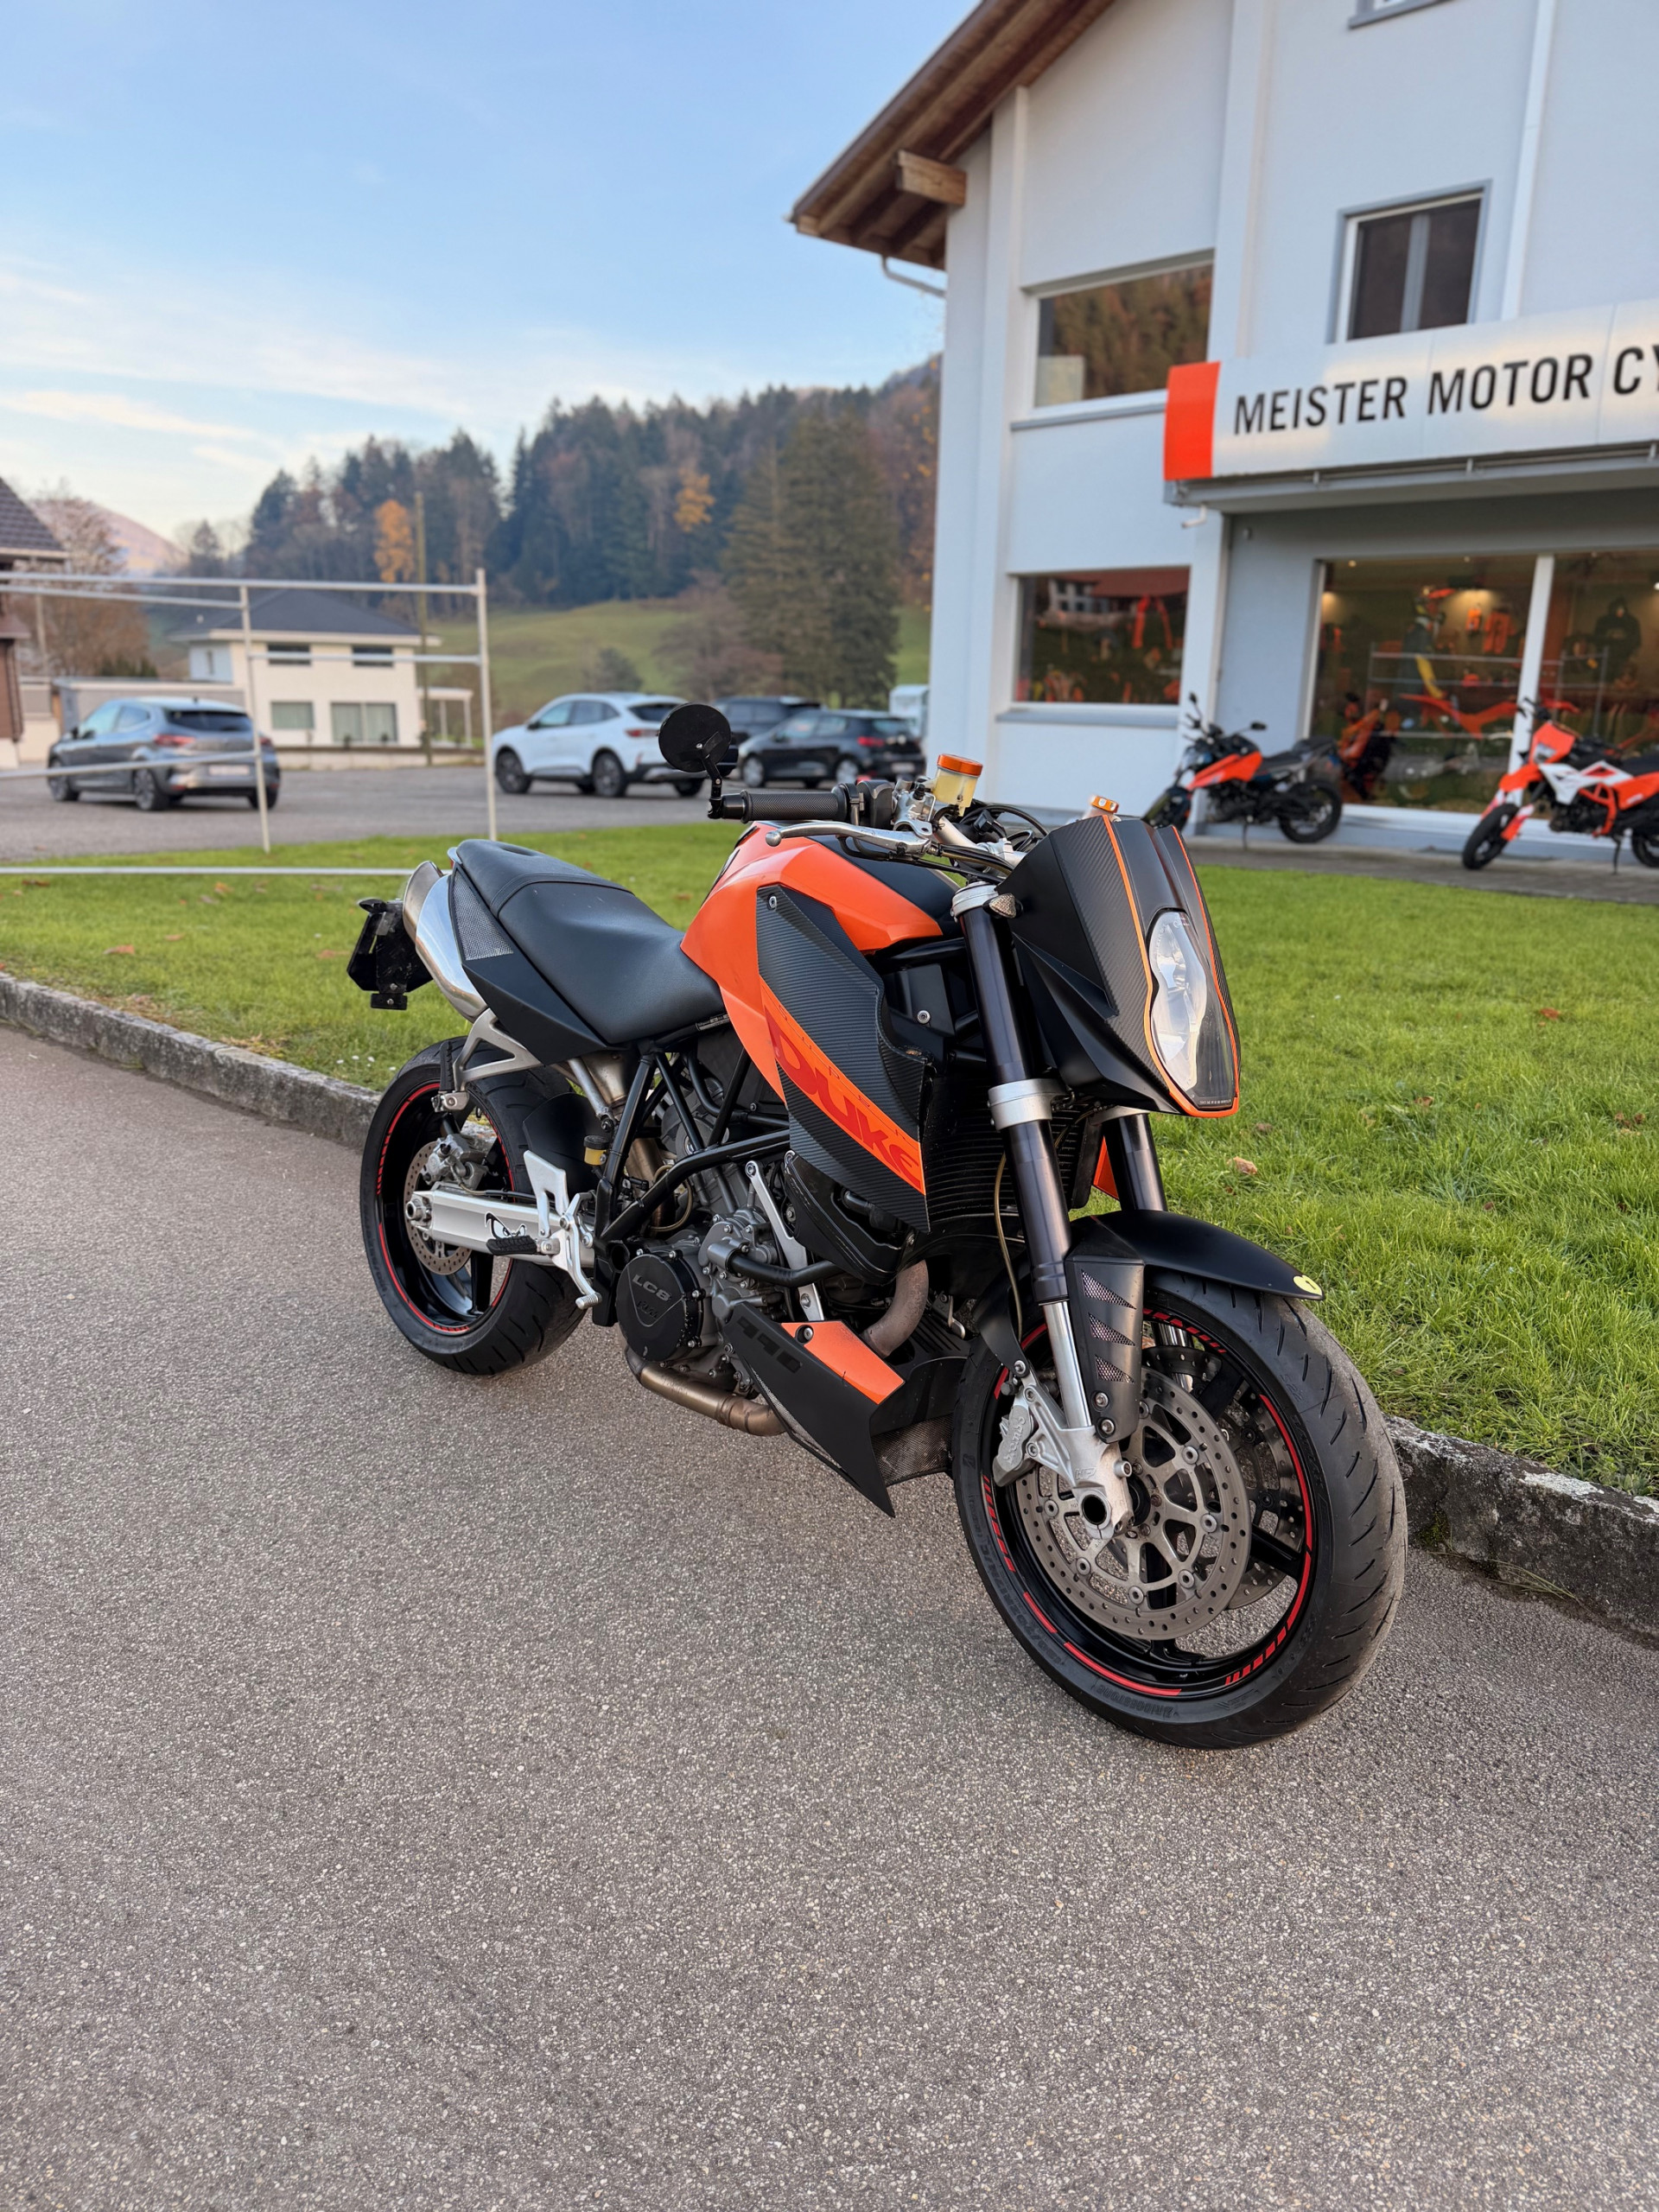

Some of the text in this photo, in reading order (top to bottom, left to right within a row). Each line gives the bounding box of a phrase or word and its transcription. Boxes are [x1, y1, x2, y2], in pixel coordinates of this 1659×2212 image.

[1234, 343, 1659, 435] MEISTER MOTOR C
[632, 1274, 672, 1301] LC8
